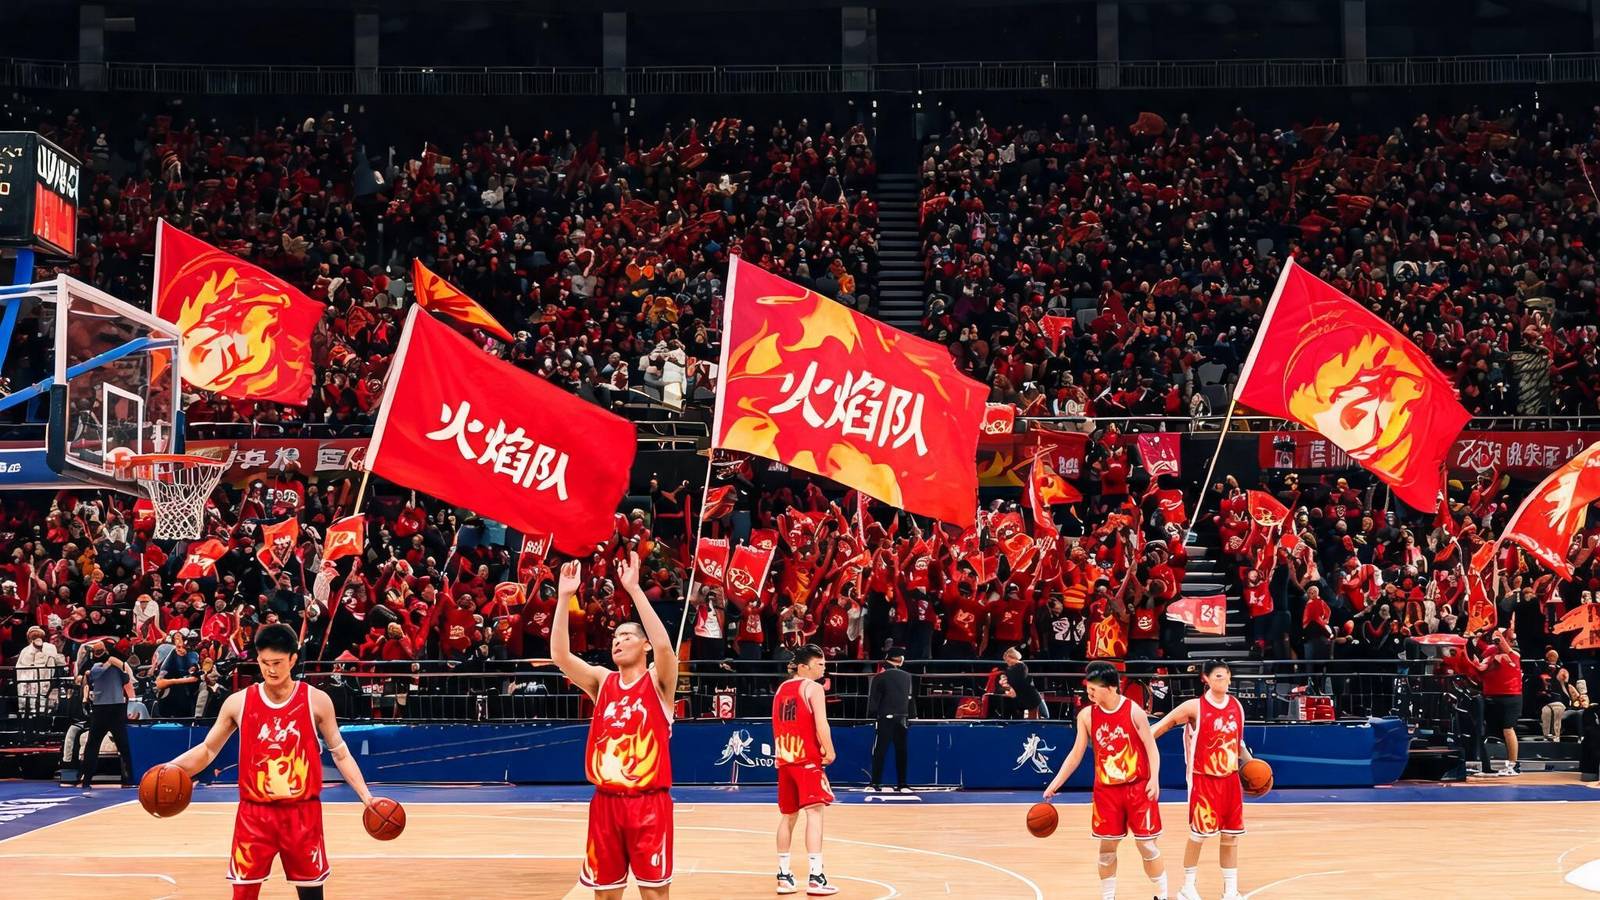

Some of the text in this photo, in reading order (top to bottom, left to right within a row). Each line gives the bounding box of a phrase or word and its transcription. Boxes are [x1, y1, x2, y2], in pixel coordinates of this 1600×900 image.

[425, 401, 569, 501] 火焰队
[768, 361, 928, 457] 火焰队
